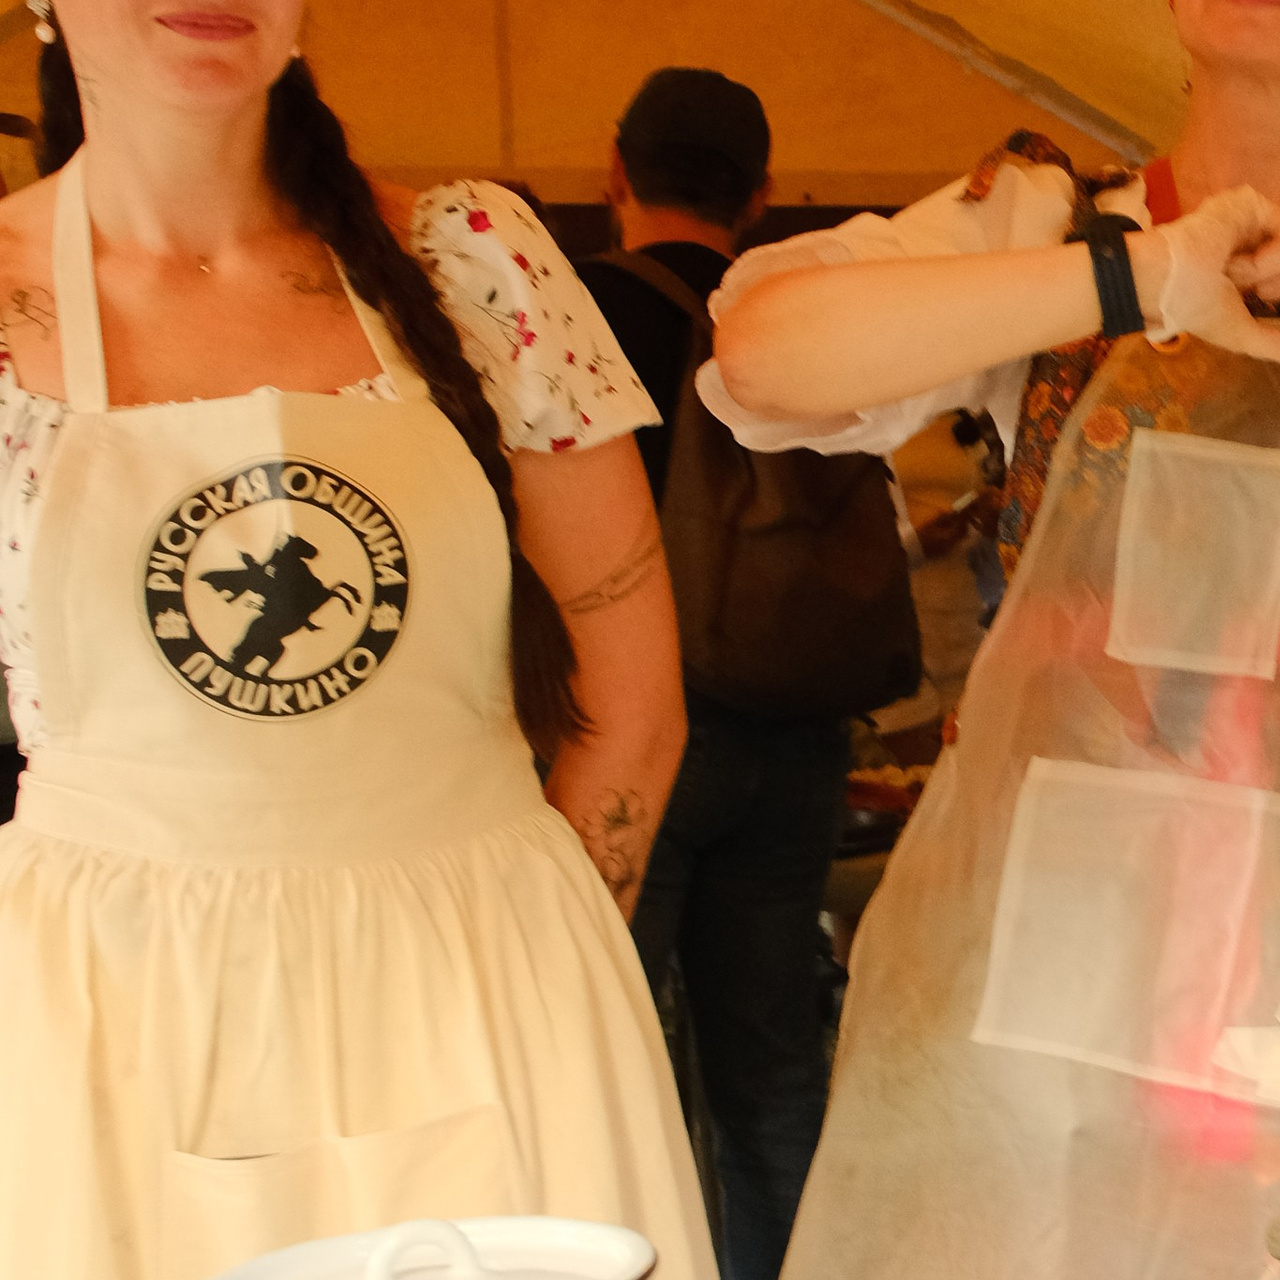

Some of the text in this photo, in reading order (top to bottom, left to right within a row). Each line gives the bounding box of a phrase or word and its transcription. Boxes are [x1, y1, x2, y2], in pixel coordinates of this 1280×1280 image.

[147, 465, 407, 590] РУССКАЯ ОБЩИНА
[179, 646, 378, 714] ПУШКИНО
